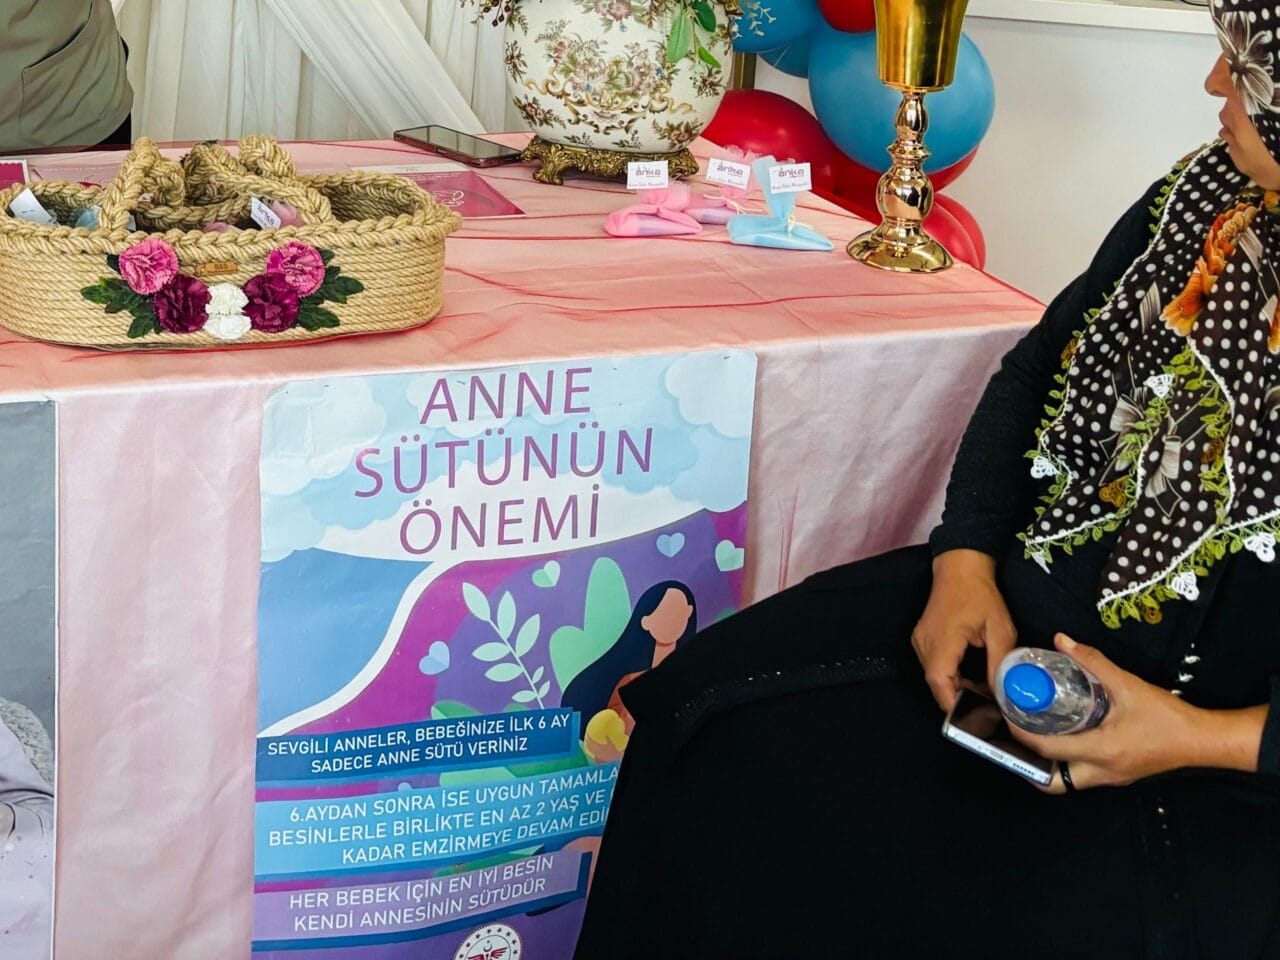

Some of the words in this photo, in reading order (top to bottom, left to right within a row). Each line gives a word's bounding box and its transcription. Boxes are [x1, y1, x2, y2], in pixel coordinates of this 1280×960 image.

[420, 367, 592, 424] ANNE
[354, 421, 653, 498] SÜTÜNÜN
[399, 483, 599, 555] ÖNEMİ
[267, 737, 328, 756] SEVGİLİ
[333, 730, 410, 753] ANNELER,
[415, 718, 505, 742] BEBEĞİNİZE
[510, 716, 533, 732] İLK
[538, 717, 546, 729] 6
[551, 713, 570, 728] AY
[311, 755, 373, 773] SADECE
[377, 748, 420, 767] ANNE
[425, 741, 463, 760] SÜTÜ
[468, 737, 528, 756] VERİNİZ
[270, 822, 387, 847] BESİNLERLE
[393, 812, 474, 836] BİRLİKTE
[480, 809, 504, 826] EN
[509, 804, 531, 820] AZ
[535, 802, 545, 816] 2
[550, 795, 580, 813] YAŞ
[586, 789, 606, 805] VE
[289, 802, 367, 822] 6.AYDAN
[373, 795, 436, 815] SONRA
[442, 790, 469, 807] İSE
[476, 783, 534, 804] UYGUN
[539, 767, 619, 792] TAMAMLA
[342, 843, 406, 864] KADAR
[412, 828, 513, 857] EMZİRMEYE
[517, 815, 574, 840] DEVAM
[579, 807, 609, 827] EDİ
[290, 891, 329, 909] HER
[336, 885, 405, 907] BEBEK
[406, 877, 442, 903] İÇİN
[449, 876, 472, 893] EN
[478, 868, 498, 887] İYİ
[503, 855, 554, 881] BESİN
[294, 910, 354, 932] KENDİ
[360, 897, 462, 928] ANNESİNİN
[468, 877, 546, 909] SÜTÜDÜR
